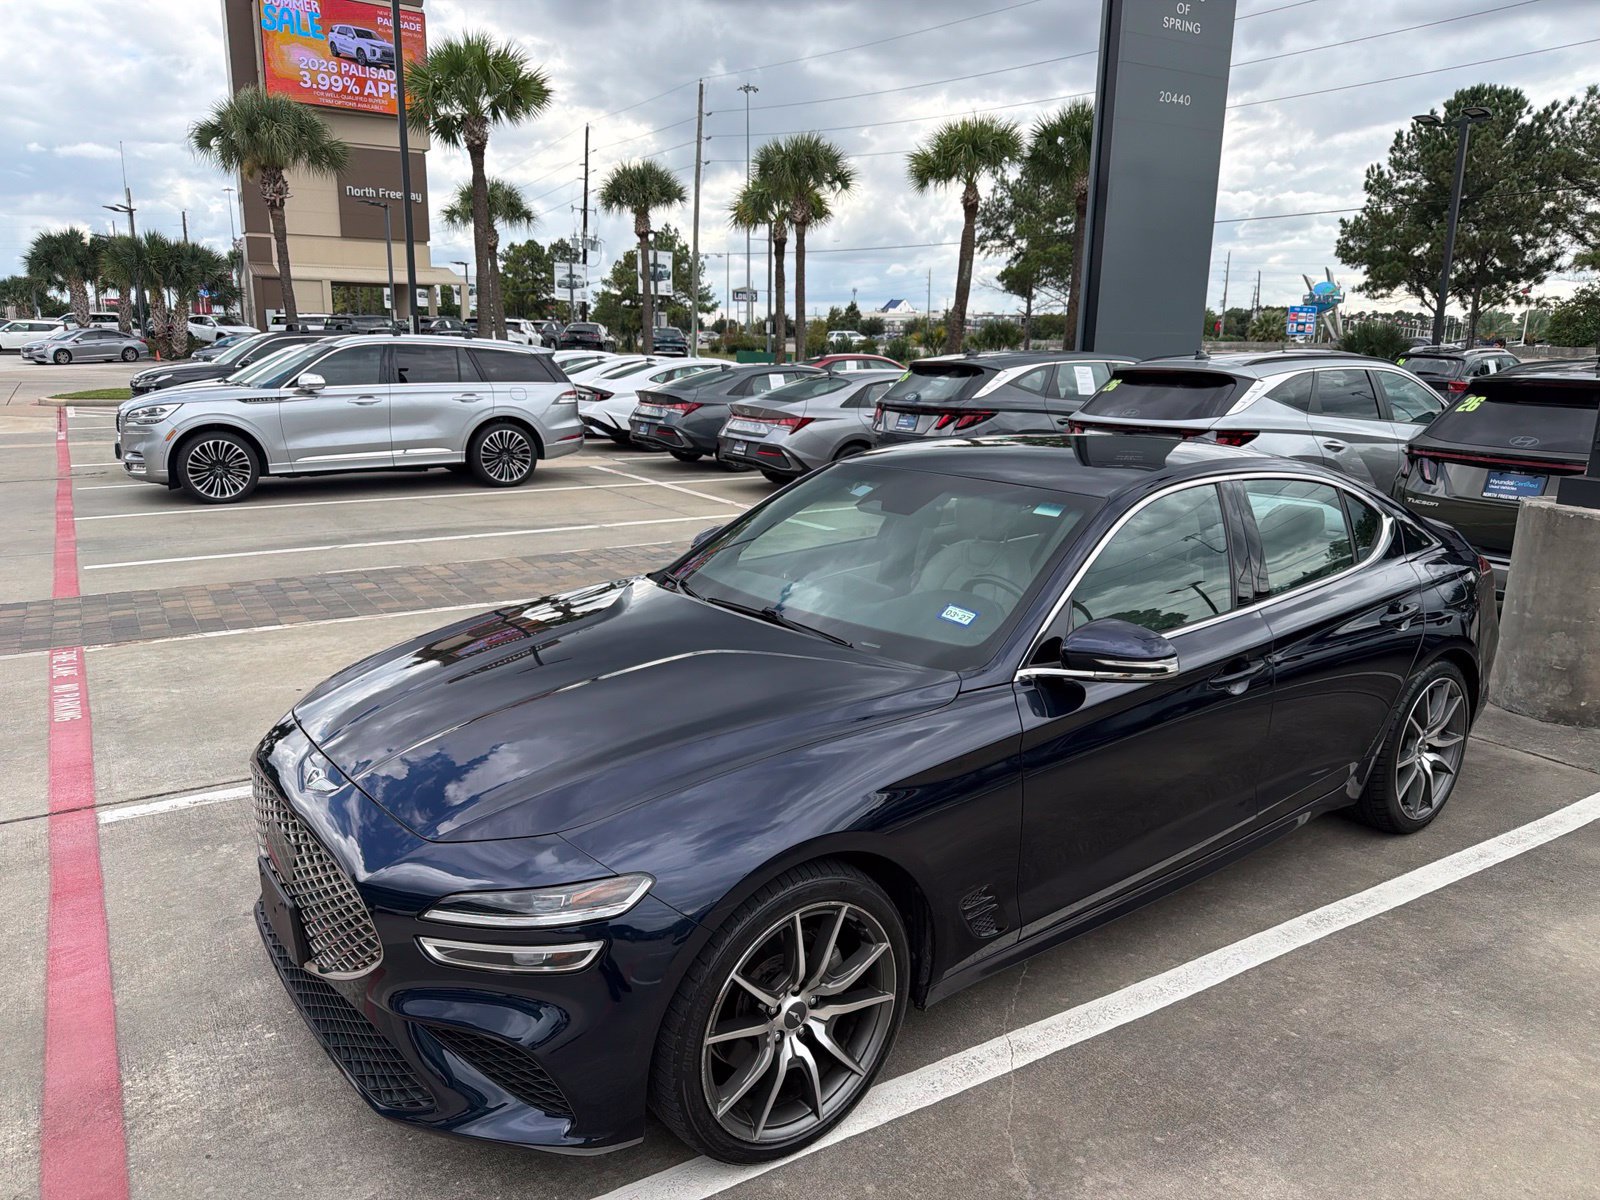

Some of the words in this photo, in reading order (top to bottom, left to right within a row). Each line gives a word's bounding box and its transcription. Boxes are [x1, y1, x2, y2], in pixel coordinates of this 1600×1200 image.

[263, 0, 320, 13] UMMER
[1176, 2, 1191, 15] OF
[261, 4, 325, 40] SALE
[1162, 16, 1201, 34] SPRING
[299, 57, 338, 73] 2026
[340, 62, 396, 82] PALISAD
[299, 70, 360, 95] 3.99%
[1159, 91, 1191, 106] 20440
[346, 185, 376, 198] North
[378, 188, 422, 203] Freeay
[1455, 396, 1487, 412] 26
